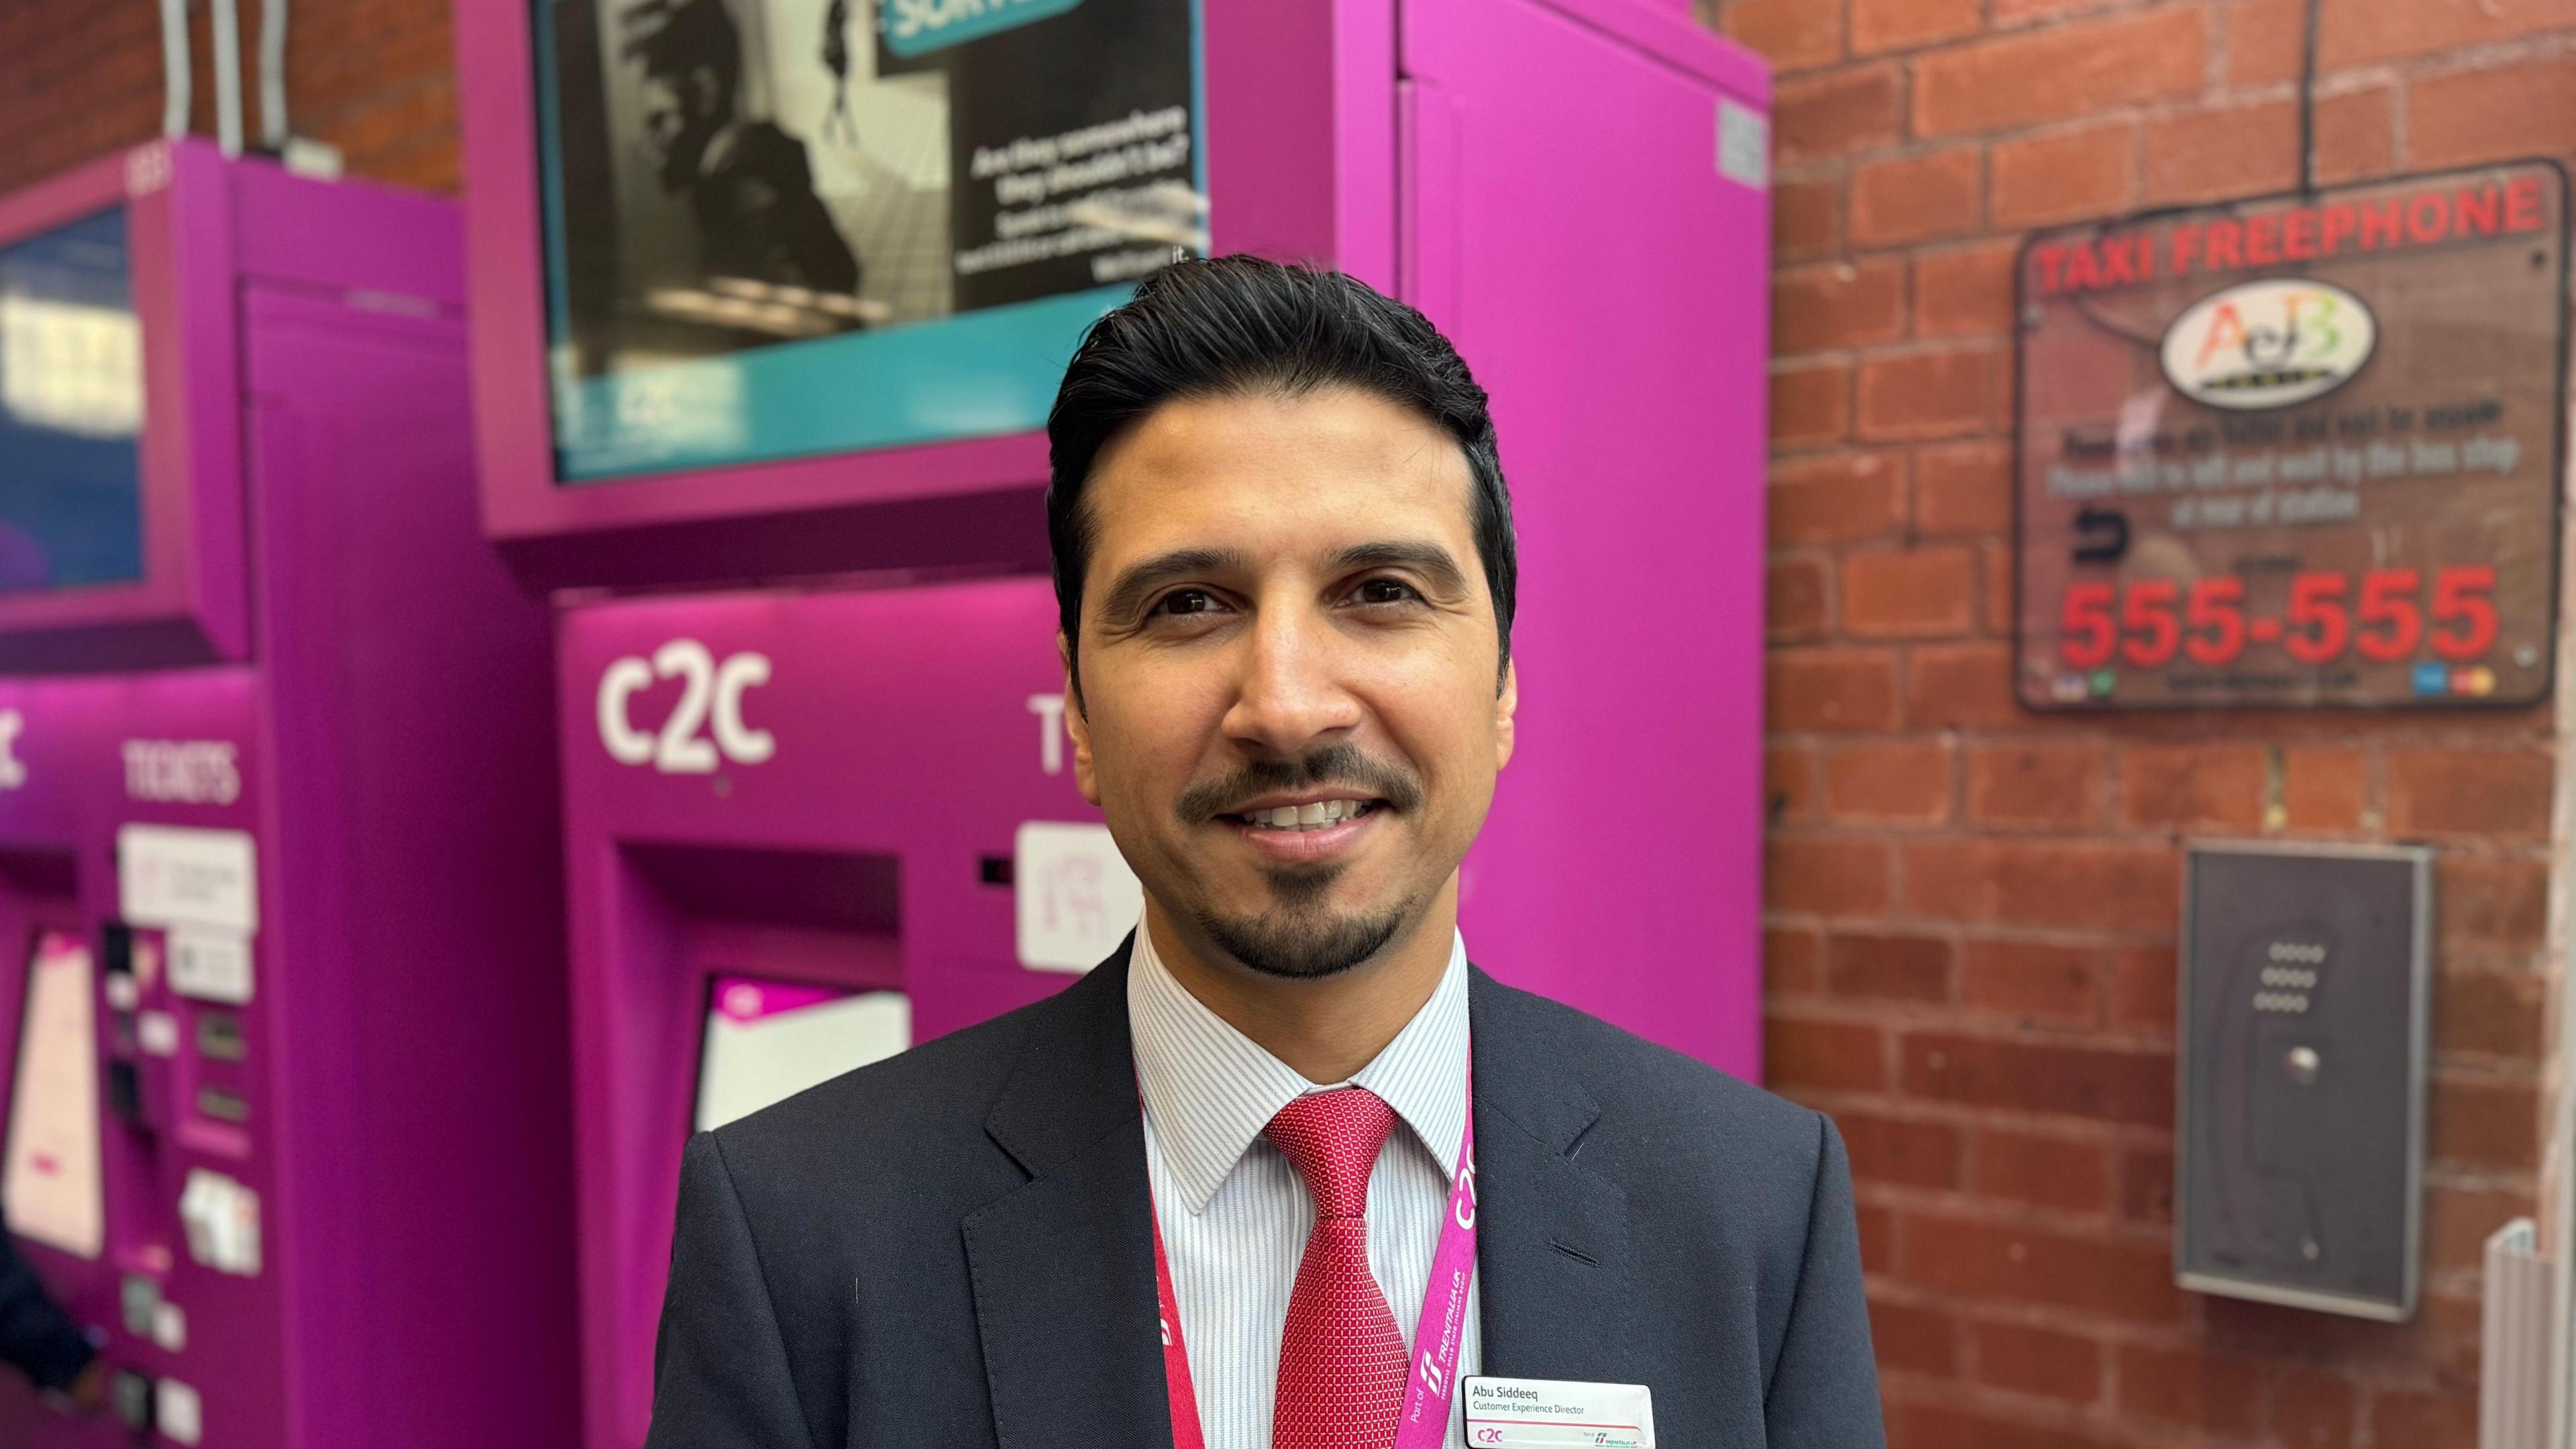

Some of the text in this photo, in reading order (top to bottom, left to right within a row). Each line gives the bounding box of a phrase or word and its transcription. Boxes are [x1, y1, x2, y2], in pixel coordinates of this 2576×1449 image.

[1008, 136, 1058, 170] they
[1058, 105, 1187, 160] somewhere
[2035, 178, 2543, 294] TAXI FREEPHONE
[2060, 566, 2498, 668] 555-555
[119, 739, 242, 807] TICKETS
[1438, 1267, 1461, 1363] TRENITALIA UK
[1450, 1326, 1458, 1346] STATO
[1410, 1387, 1425, 1424] Part of
[1472, 1385, 1538, 1402] Abu Siddeeq
[1473, 1401, 1584, 1414] Customer Experience Director
